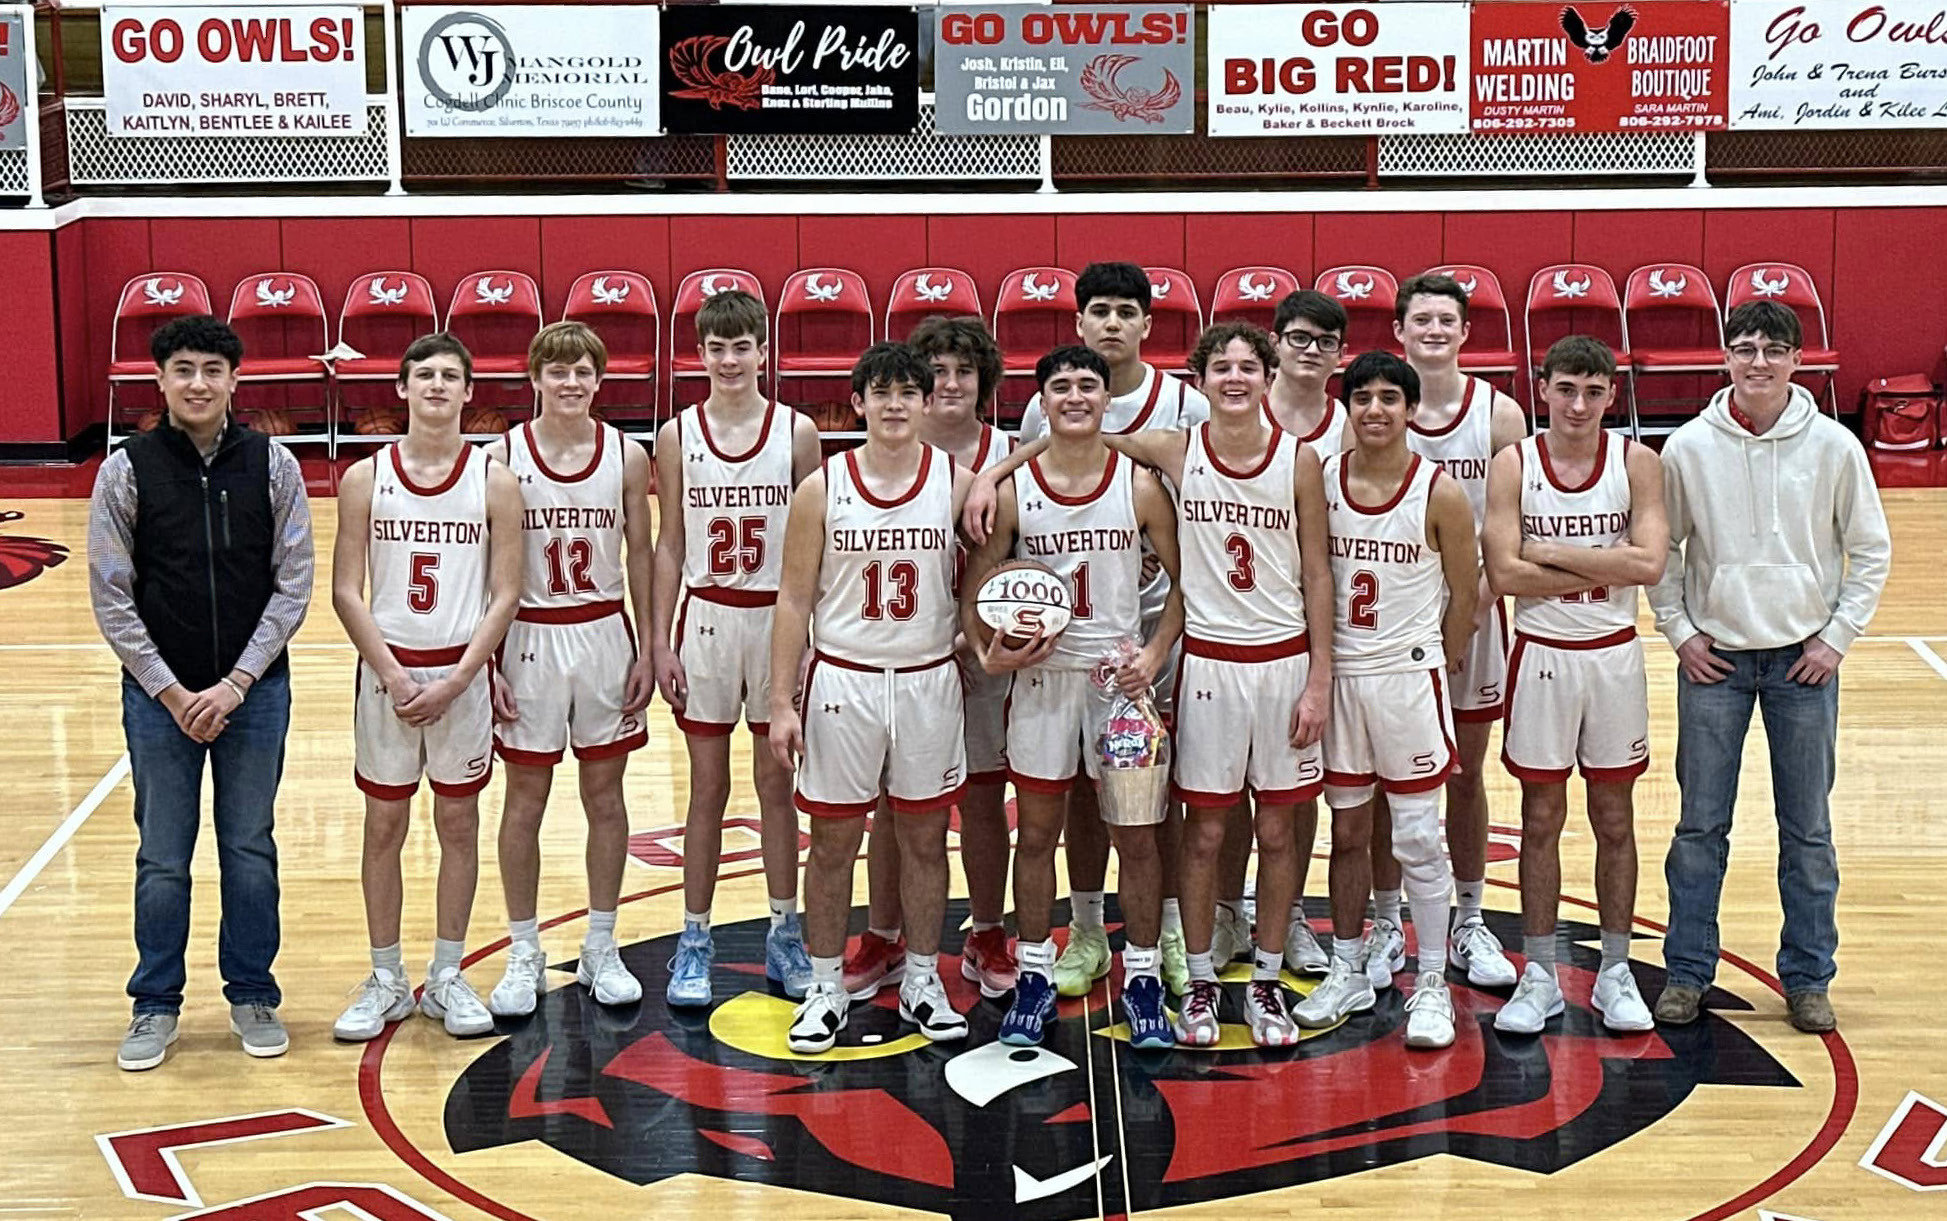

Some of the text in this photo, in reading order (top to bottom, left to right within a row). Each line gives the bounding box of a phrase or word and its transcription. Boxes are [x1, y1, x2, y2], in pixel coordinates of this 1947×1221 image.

[112, 18, 354, 63] GO OWLS!
[941, 12, 1187, 45] GO OWLS!
[1301, 9, 1379, 47] GO
[1765, 6, 1822, 60] Go
[437, 35, 499, 86] WJ
[724, 20, 911, 74] Owl Pride
[1483, 38, 1567, 67] MARTIN
[1627, 36, 1717, 64] BRAIDFOOT
[506, 56, 642, 68] MANGOLD
[960, 57, 997, 72] Josh,
[1000, 57, 1047, 72] Kristin,
[1224, 55, 1456, 95] BIG RED!
[1750, 64, 1797, 87] John
[1807, 63, 1823, 79] &
[1831, 63, 1890, 81] Trena
[503, 73, 647, 84] MEMORIAL
[974, 76, 1056, 90] Bristol & Jax
[1475, 73, 1575, 102] WELDING
[1631, 69, 1711, 100] BOUTIQUE
[1839, 83, 1880, 98] and
[143, 93, 330, 109] DAVID, SHARYL, BRETT,
[424, 92, 642, 113] Cogdell Clinic Briscoe County
[792, 98, 800, 108] &
[802, 97, 848, 109] Sterling
[966, 93, 1068, 121] Gordon
[1216, 102, 1463, 116] Beau, Kylie, Kollins, Kynlie, Karoline,
[1483, 104, 1565, 116] DUSTY MARTIN
[1634, 102, 1709, 113] SARA MARTIN
[1794, 102, 1850, 124] Jordin
[1859, 101, 1873, 117] &
[123, 115, 352, 131] KAITLYN, BENTLEE & KAILEE
[1263, 117, 1415, 129] Baker & Beckett Brock
[688, 484, 789, 508] SILVERTON
[522, 508, 616, 530] ILVERTON
[1184, 500, 1290, 530] SILVERTON
[373, 520, 482, 544] SILVERTON
[833, 528, 947, 552] SILVERTON
[1025, 529, 1135, 555] SILVERTON
[708, 516, 768, 576] 25
[544, 537, 600, 597] 12
[1224, 532, 1256, 592] 3
[407, 552, 441, 615] 5
[862, 560, 919, 621] 13
[999, 578, 1063, 605] 1000
[1071, 561, 1093, 620] 1
[1349, 569, 1379, 630] 2
[1012, 605, 1046, 636] S
